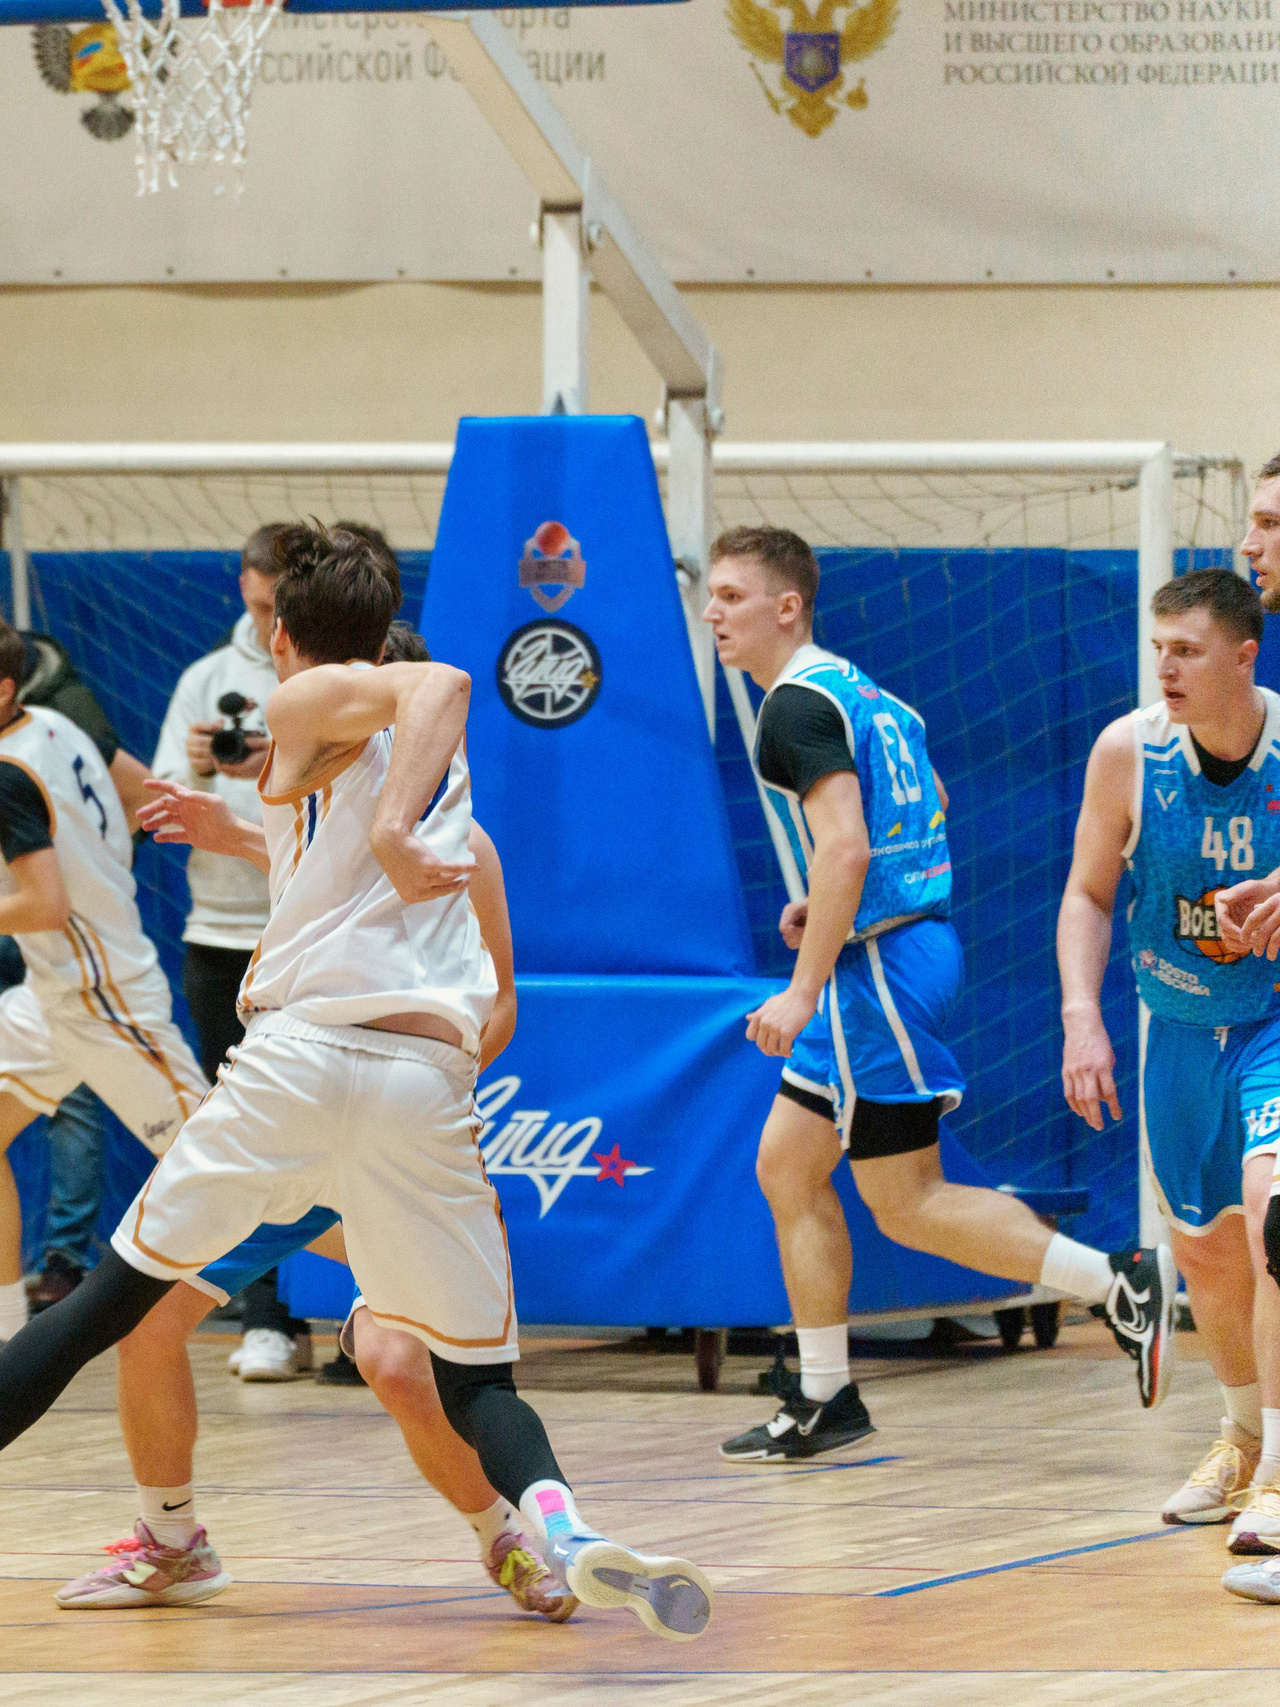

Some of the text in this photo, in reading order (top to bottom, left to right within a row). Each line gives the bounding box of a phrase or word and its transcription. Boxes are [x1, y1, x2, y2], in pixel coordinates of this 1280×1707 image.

[944, 0, 1272, 22] МИНИСТЕРСТВО НАУКИ
[945, 32, 963, 52] И
[969, 32, 1103, 53] ВЫСШЕГО
[945, 61, 1128, 85] РОССИЙСКОЙ
[72, 754, 107, 840] 5
[1200, 816, 1254, 871] 48
